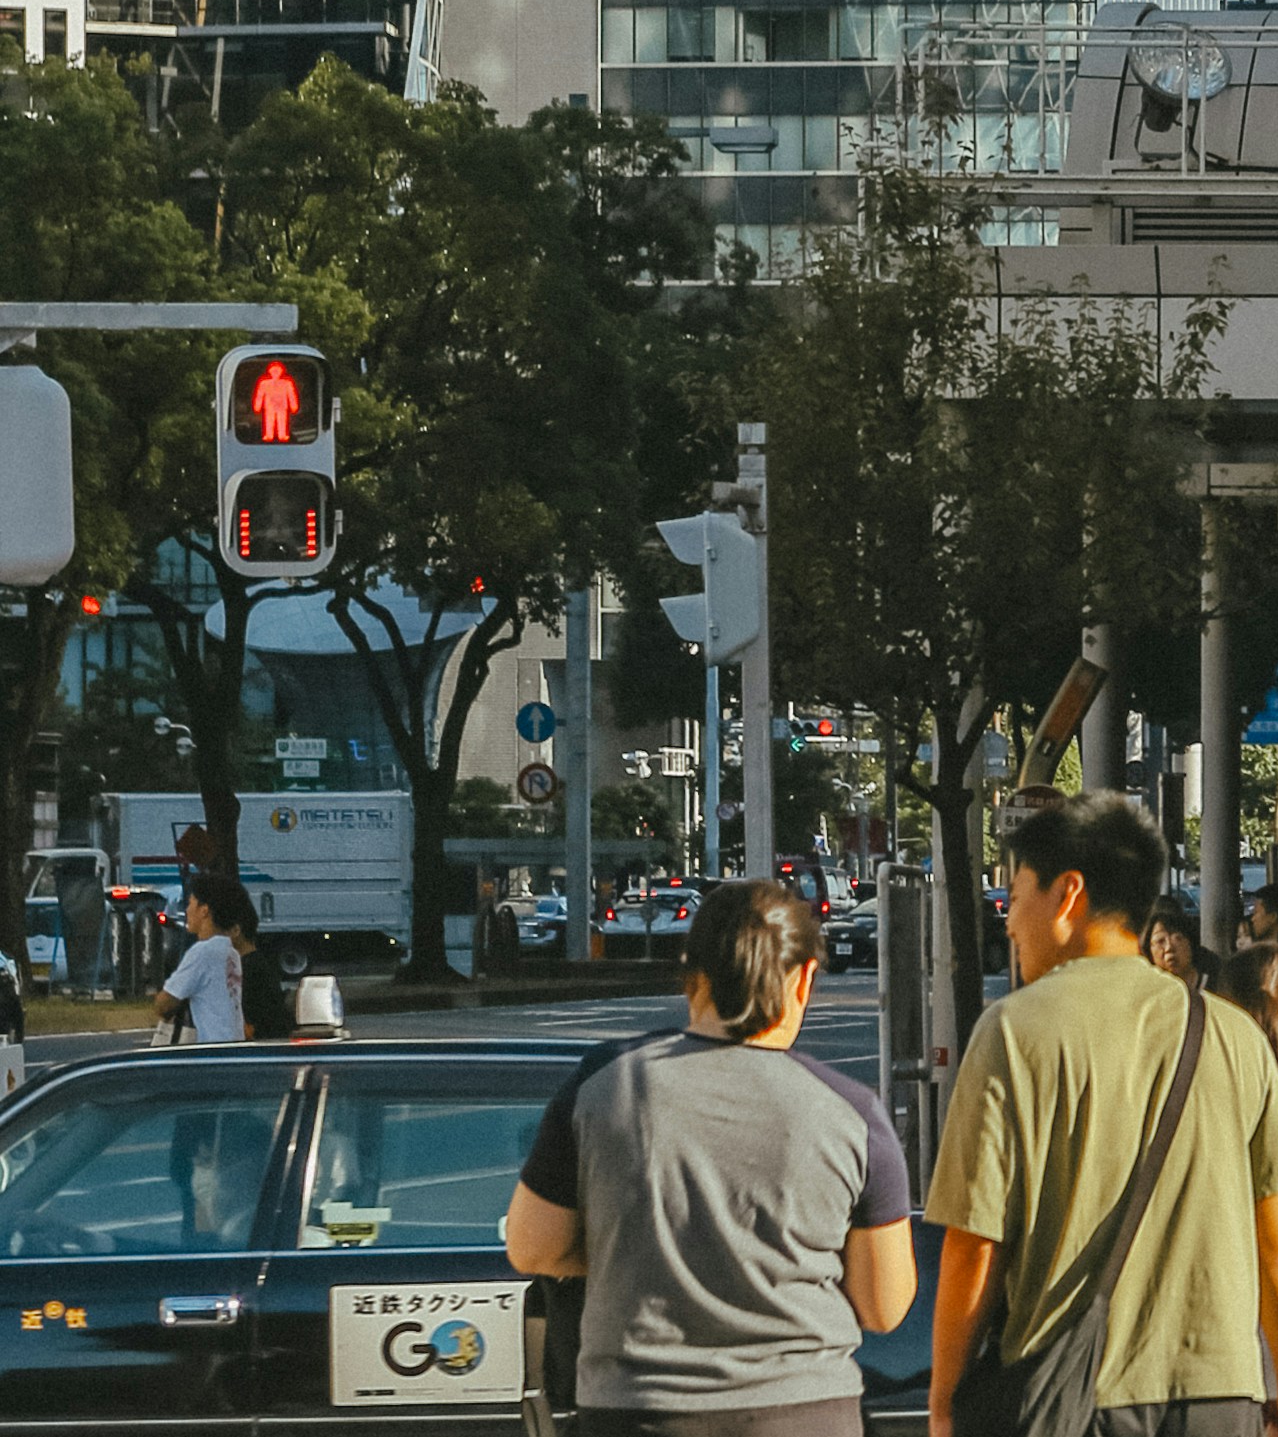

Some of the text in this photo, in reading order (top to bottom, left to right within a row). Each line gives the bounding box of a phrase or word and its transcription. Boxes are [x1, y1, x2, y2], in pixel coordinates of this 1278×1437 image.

[353, 1292, 517, 1316] 近鉄タクシーで
